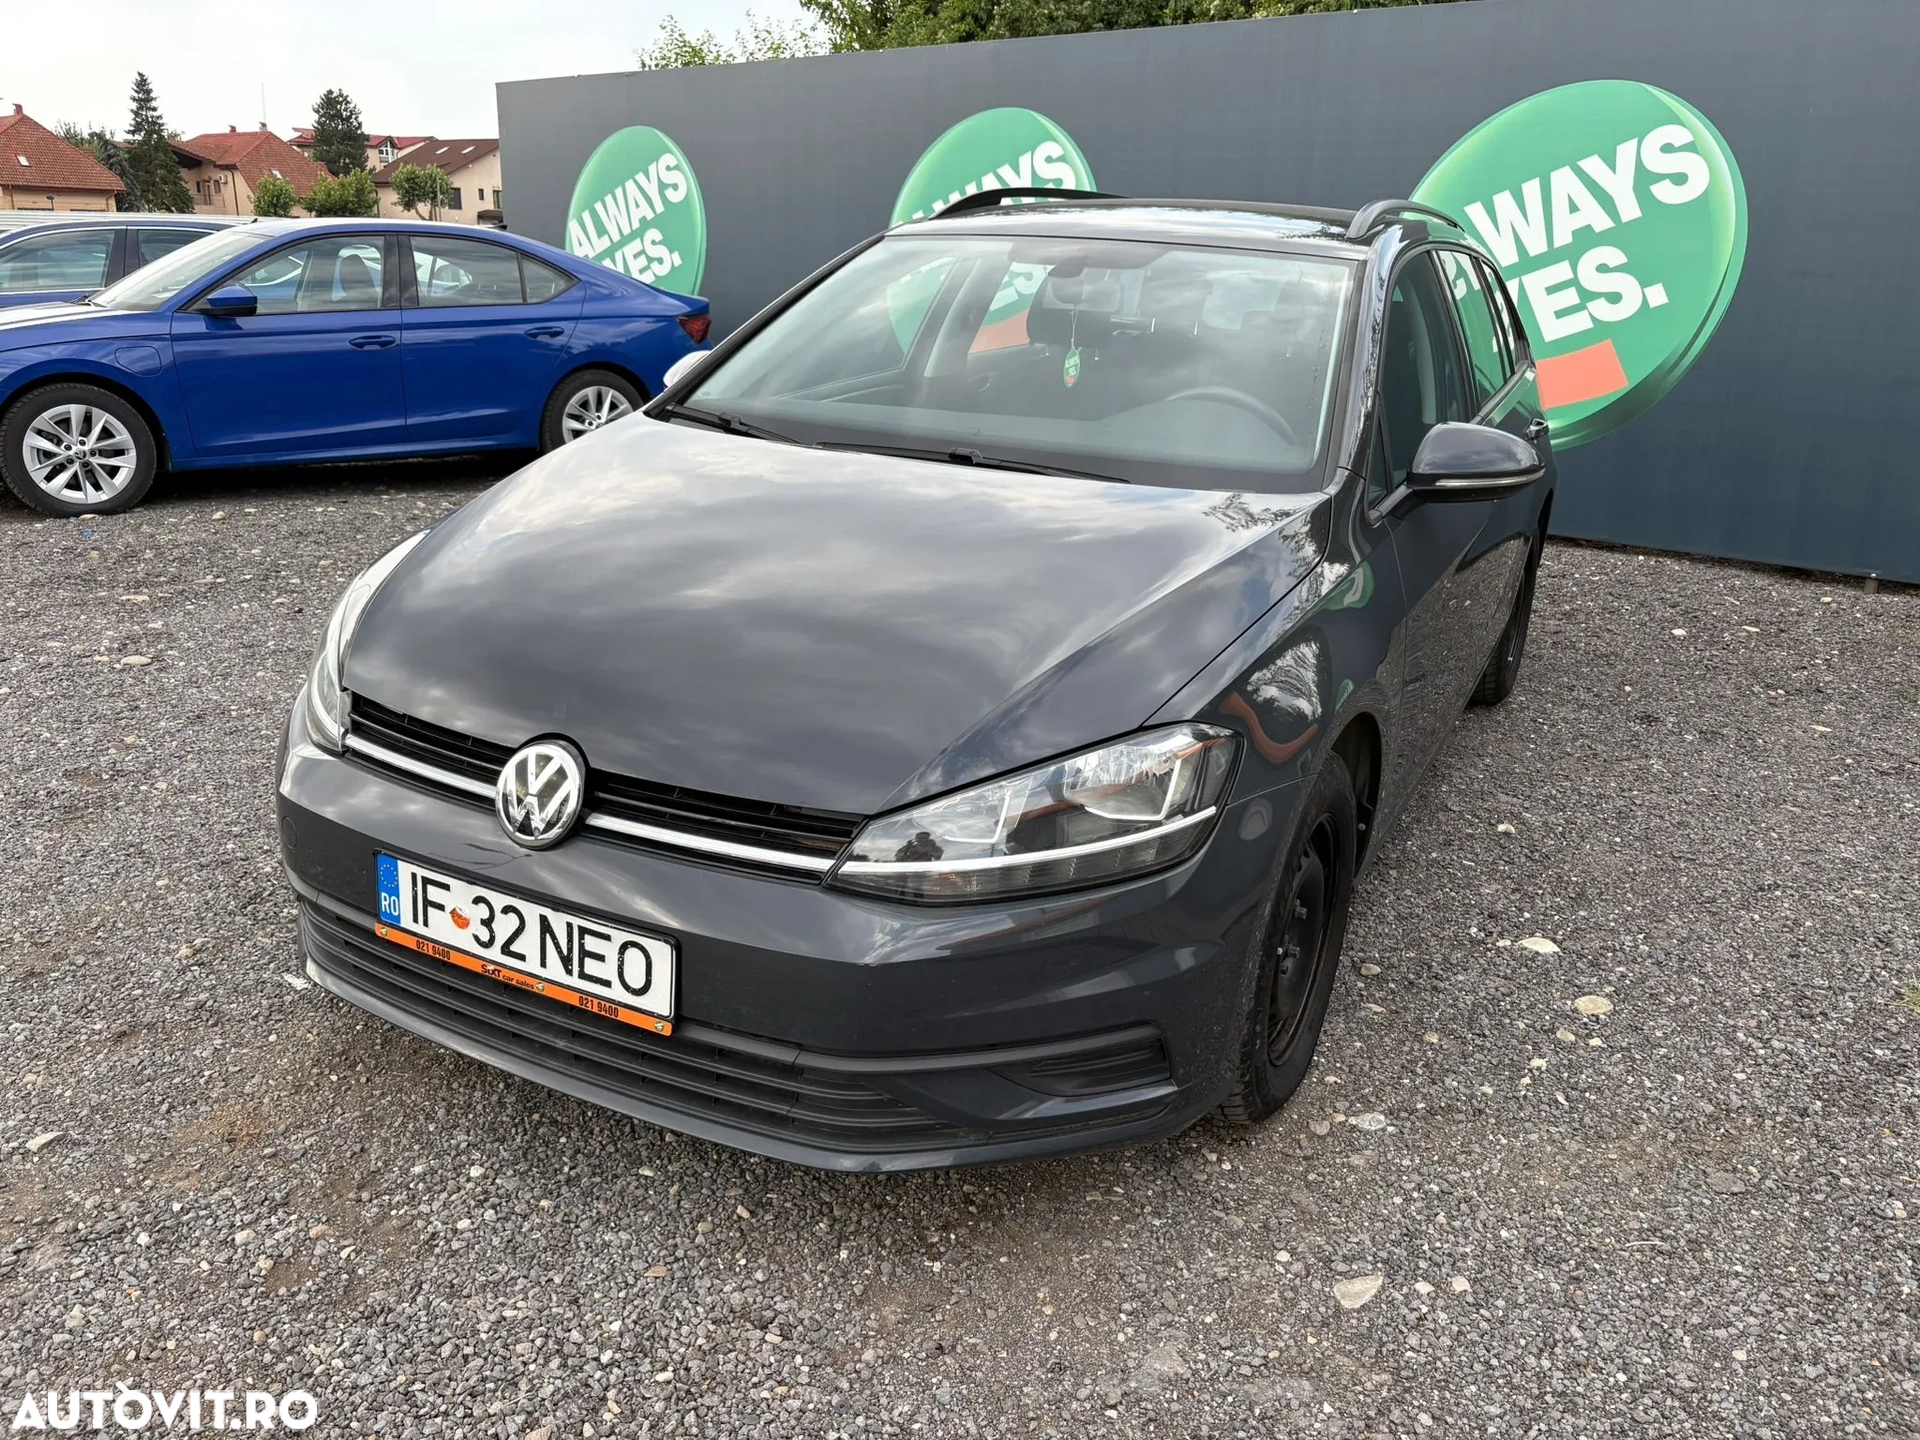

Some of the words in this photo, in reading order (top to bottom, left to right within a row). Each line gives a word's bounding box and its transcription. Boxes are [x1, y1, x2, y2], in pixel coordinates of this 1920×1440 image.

[568, 153, 688, 259] ALWAYS
[1463, 124, 1711, 268] WAYS
[381, 892, 399, 916] RO
[411, 872, 450, 928] IF
[471, 895, 526, 962] 32
[539, 913, 652, 996] NEO
[415, 939, 430, 953] 021
[431, 944, 451, 961] 9400
[502, 974, 515, 982] car
[515, 979, 535, 990] sales
[578, 995, 594, 1010] 021
[597, 1001, 619, 1018] 9400
